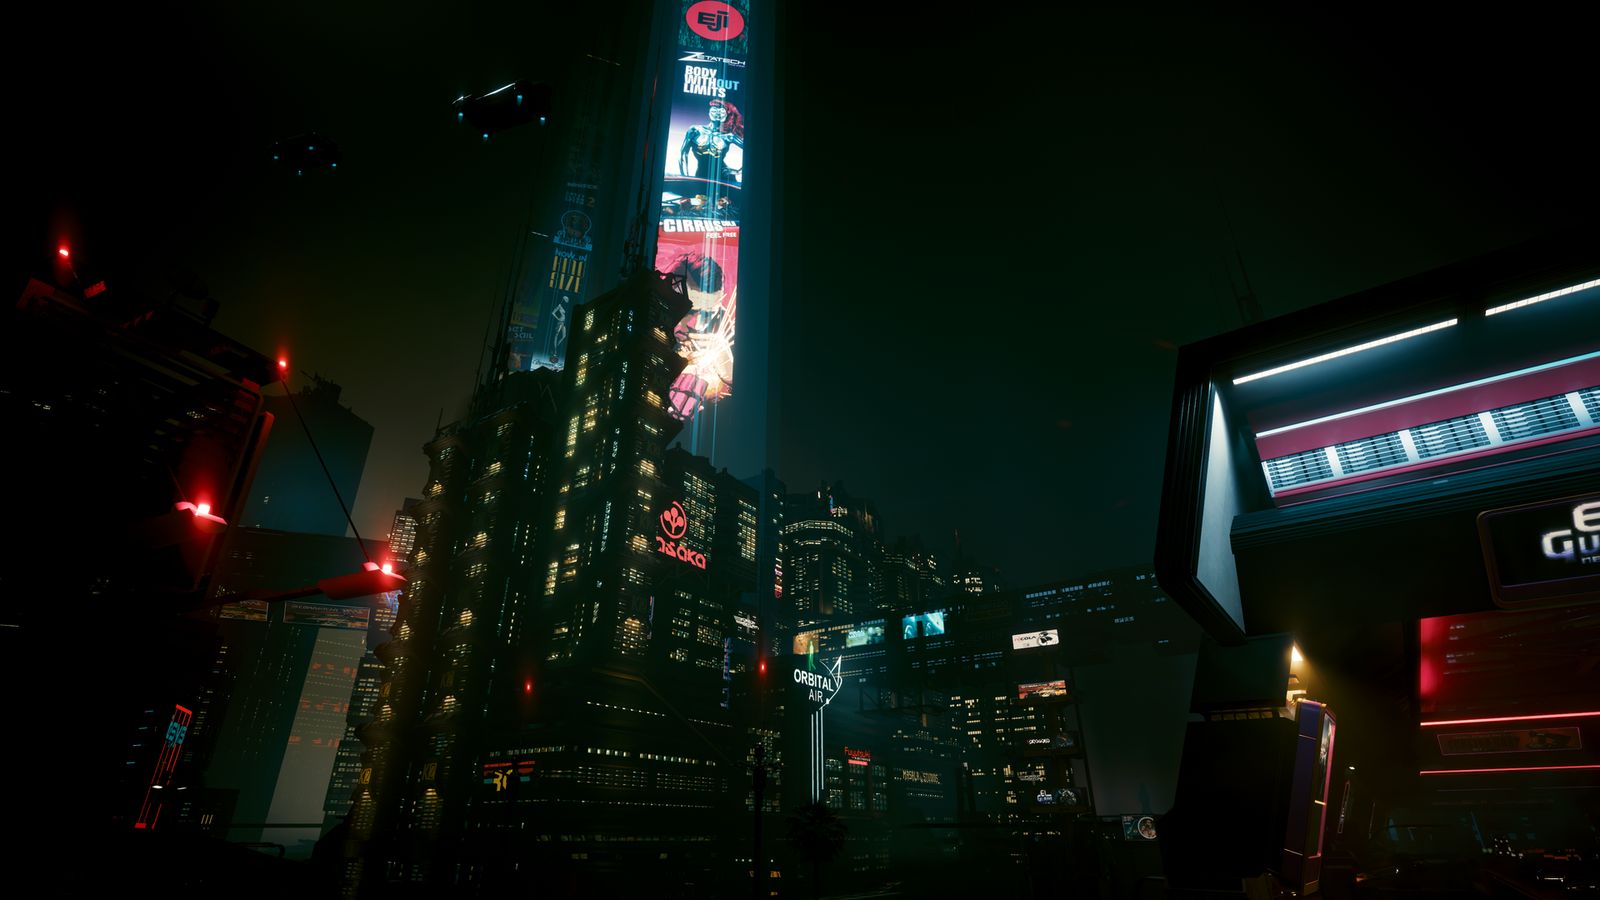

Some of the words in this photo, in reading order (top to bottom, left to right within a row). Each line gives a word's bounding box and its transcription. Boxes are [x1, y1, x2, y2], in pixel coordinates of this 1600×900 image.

[677, 50, 746, 66] ZETATECH
[685, 65, 718, 77] BODY
[684, 73, 740, 90] WITHOUT
[683, 82, 726, 98] LIMITS
[663, 219, 724, 232] CIRRUS
[793, 668, 834, 692] ORBITAL
[808, 689, 824, 703] AIR
